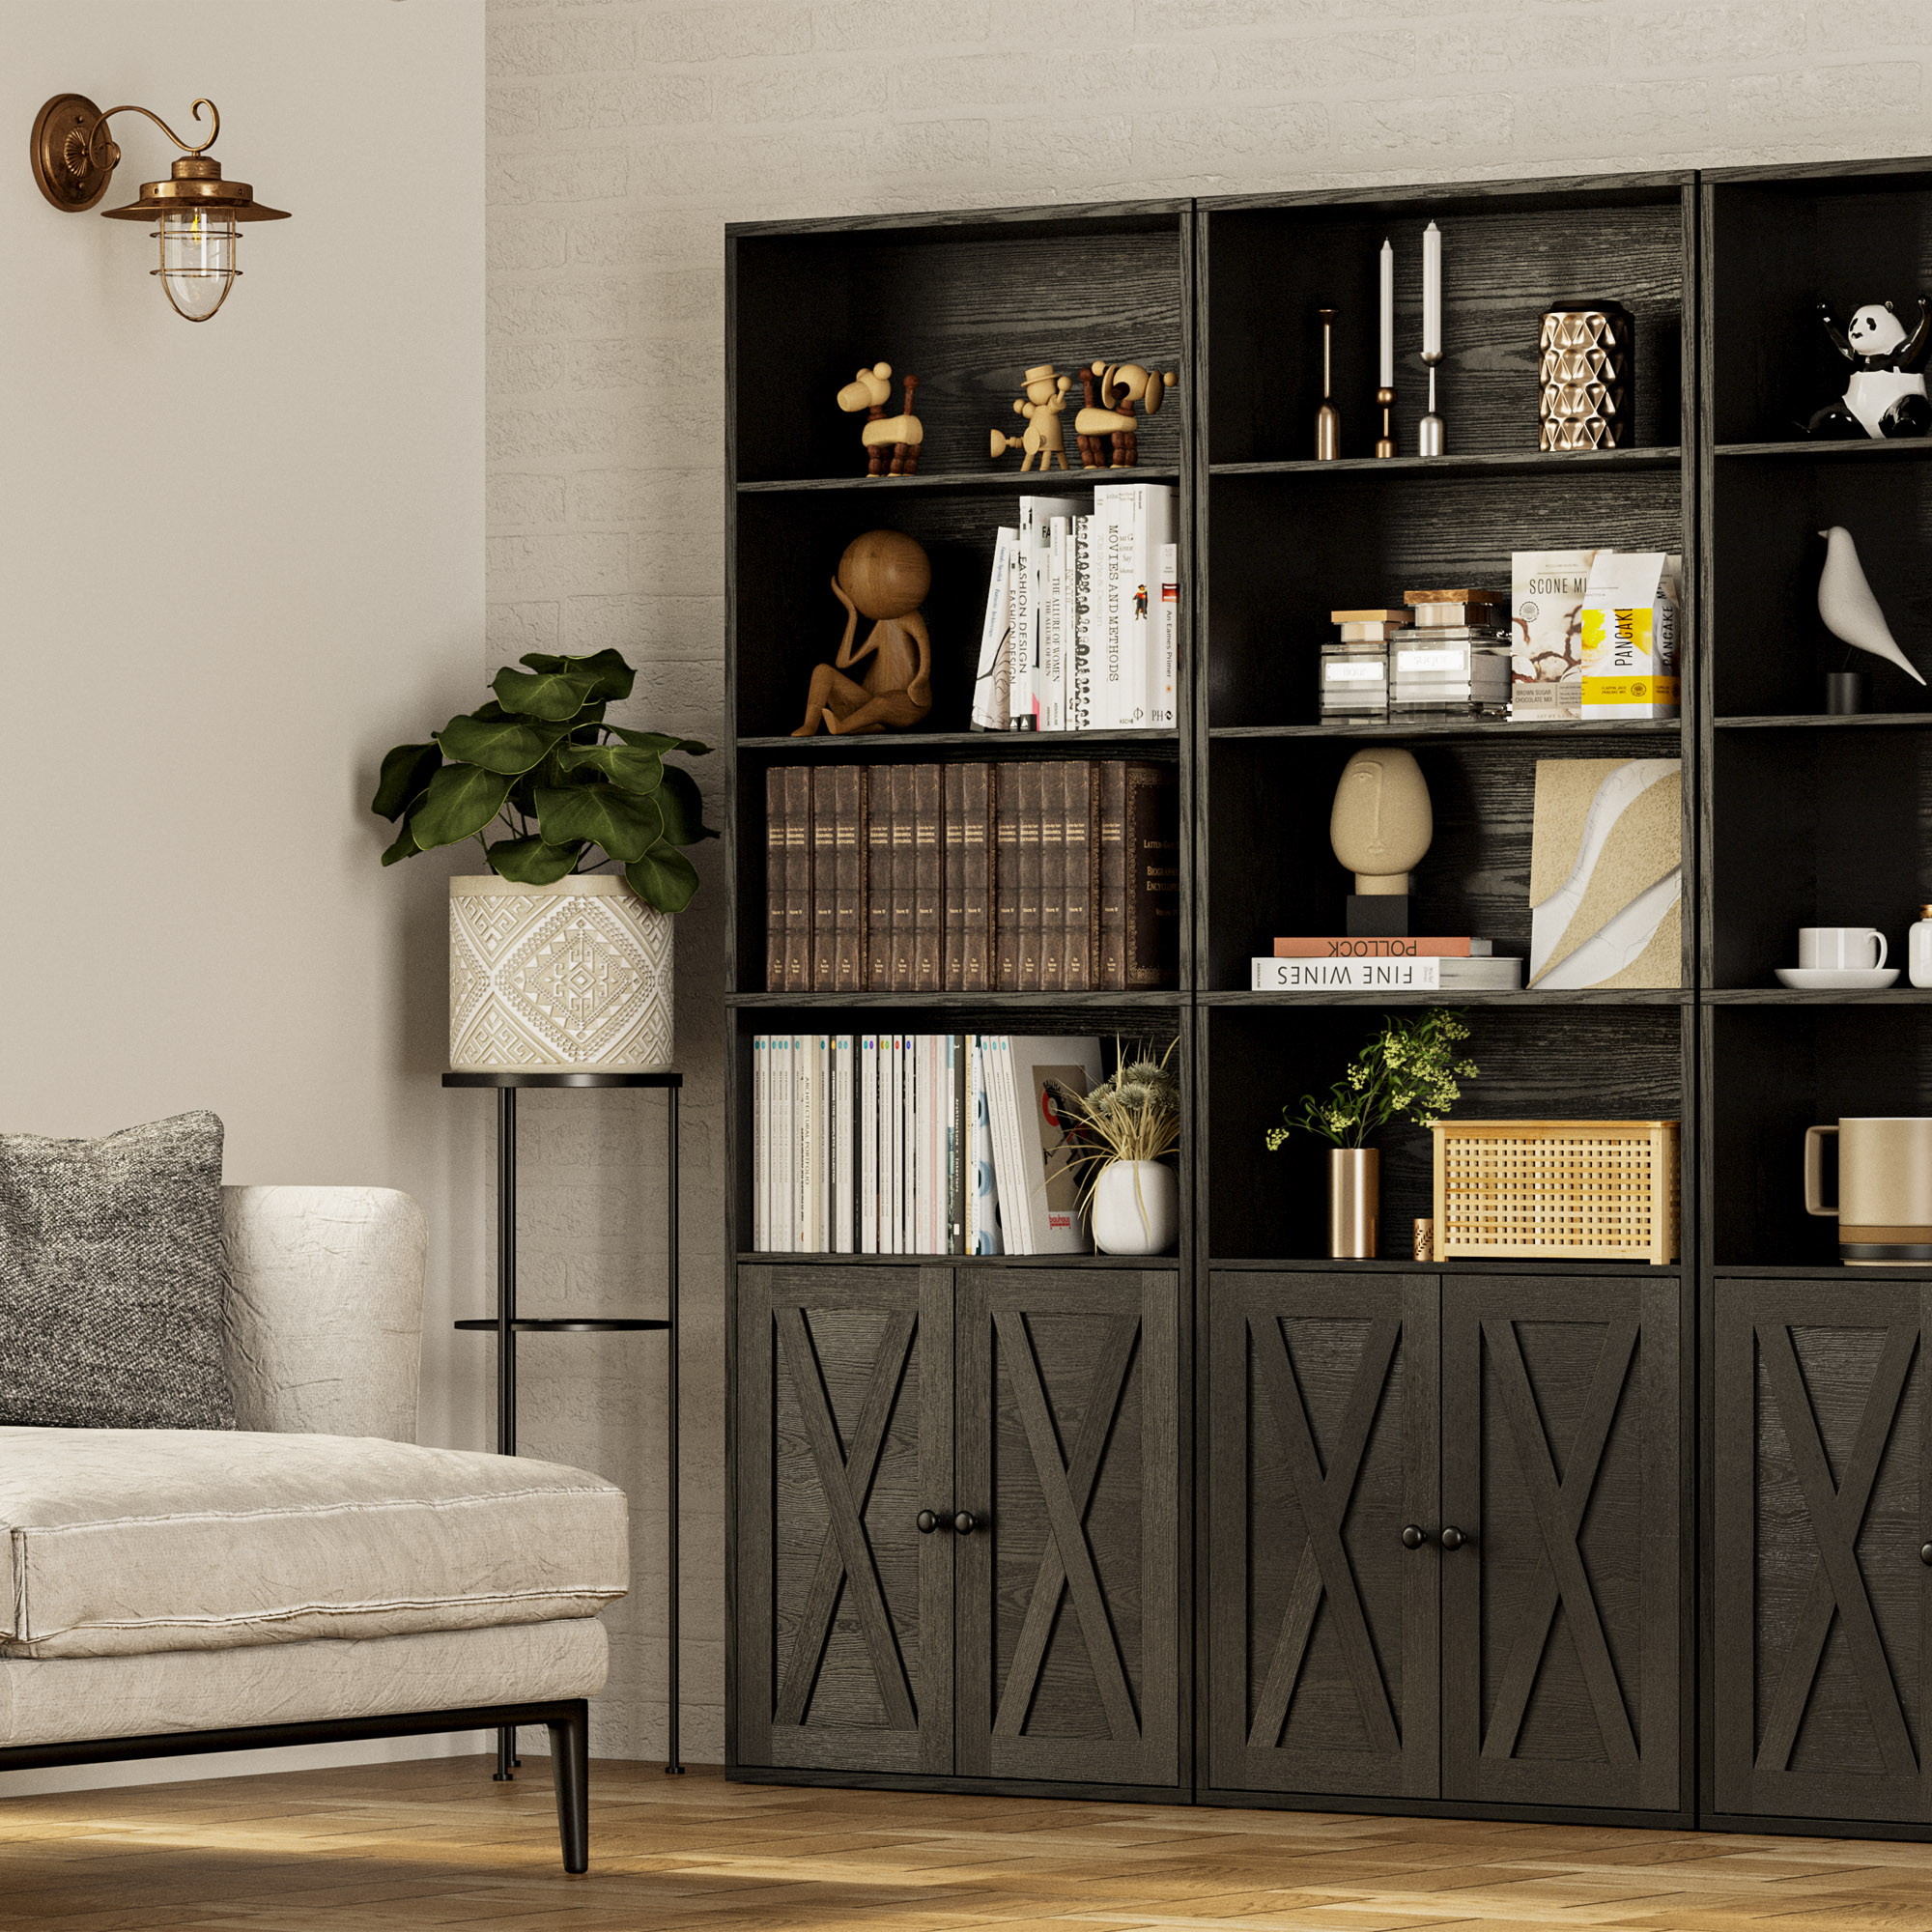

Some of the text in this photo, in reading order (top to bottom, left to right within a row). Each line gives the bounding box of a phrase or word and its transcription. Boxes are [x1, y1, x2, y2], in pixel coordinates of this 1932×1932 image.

[1529, 577, 1587, 594] SCONE MI
[1109, 525, 1119, 682] MOVIES AND METHODS
[1167, 611, 1172, 621] An
[1052, 634, 1060, 646] OF
[1662, 606, 1673, 667] PANCAKE
[1327, 940, 1417, 957] POLLOCK
[1277, 966, 1351, 984] WINES
[1363, 966, 1412, 984] FINE
